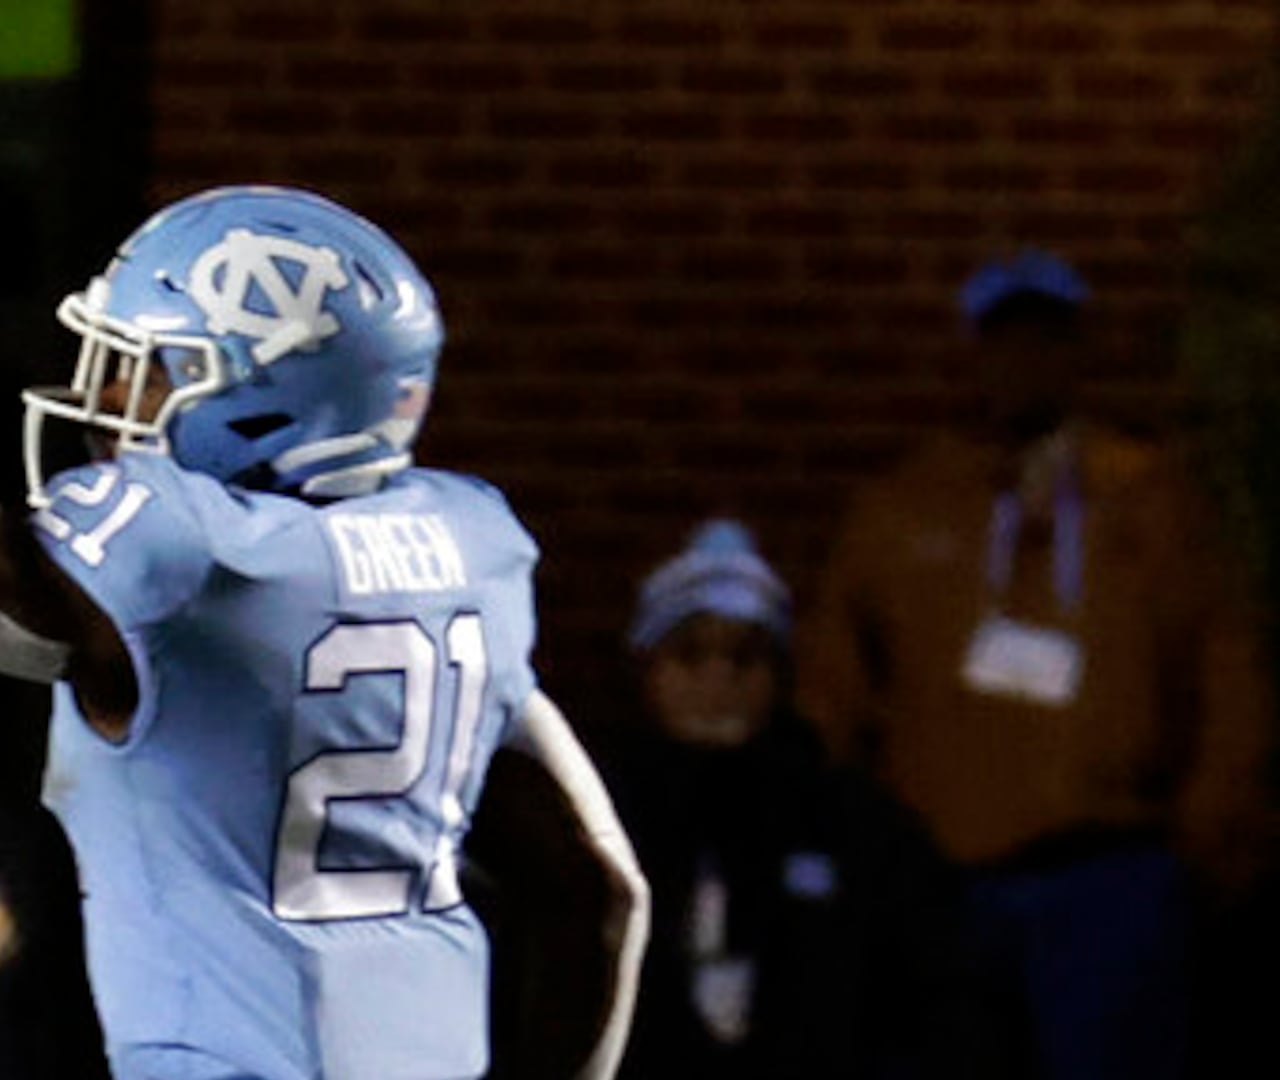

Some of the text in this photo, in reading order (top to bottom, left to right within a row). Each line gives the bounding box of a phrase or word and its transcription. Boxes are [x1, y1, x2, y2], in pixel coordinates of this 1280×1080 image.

[34, 464, 152, 566] 21
[329, 513, 468, 594] GREEN
[272, 609, 487, 921] 21
